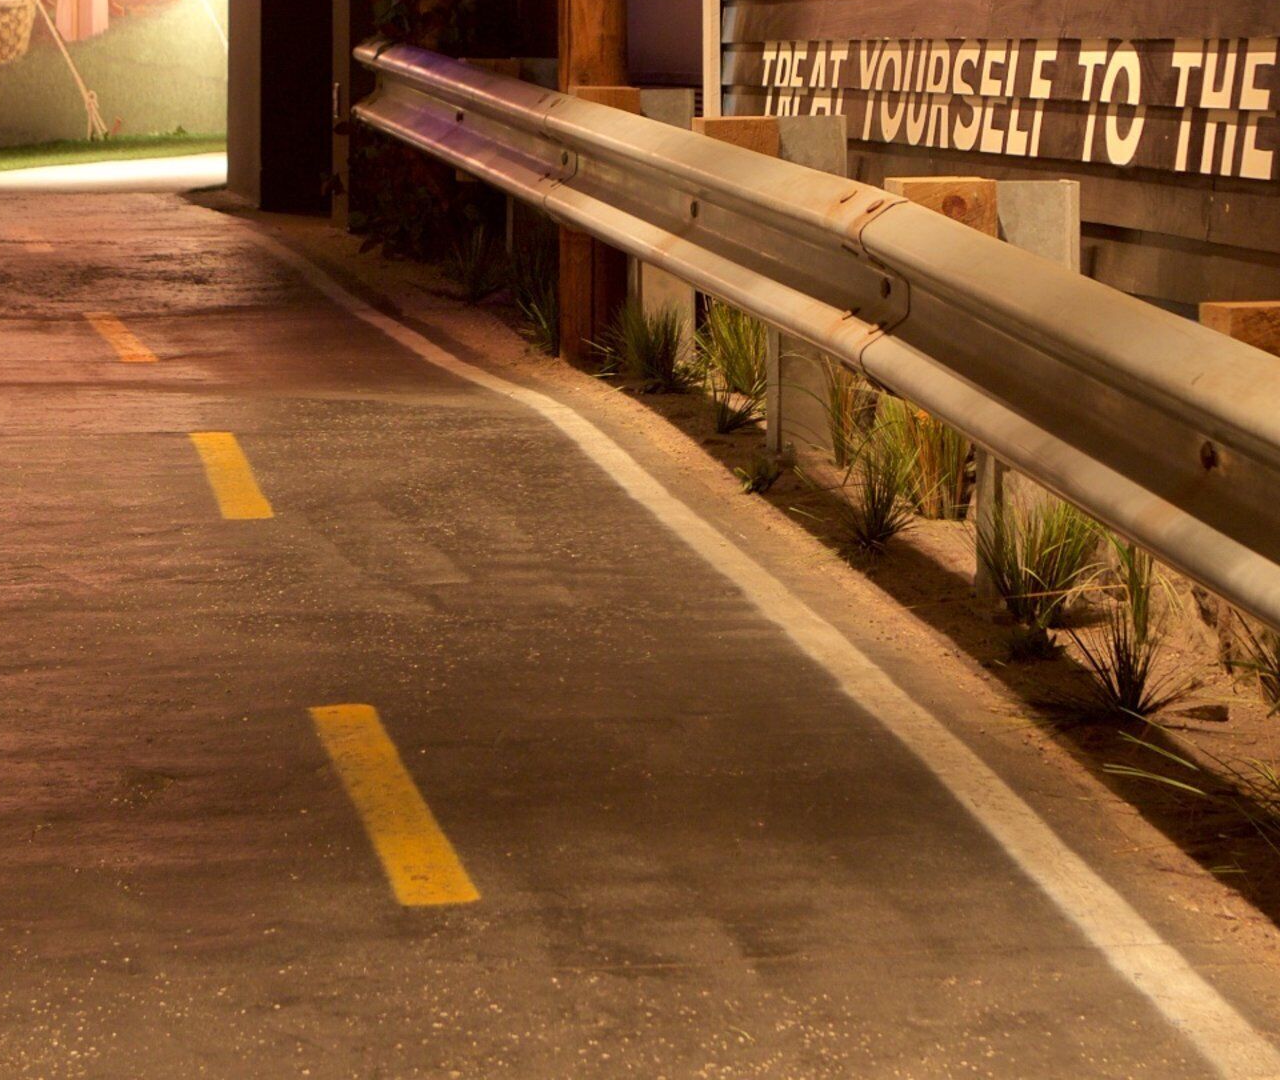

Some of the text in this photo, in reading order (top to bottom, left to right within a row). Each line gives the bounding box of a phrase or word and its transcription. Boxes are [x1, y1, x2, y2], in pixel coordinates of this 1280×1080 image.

[762, 39, 849, 117] TREAT
[859, 38, 1059, 157] YOURSELF
[1078, 38, 1146, 166] TO
[1171, 37, 1279, 180] THE
